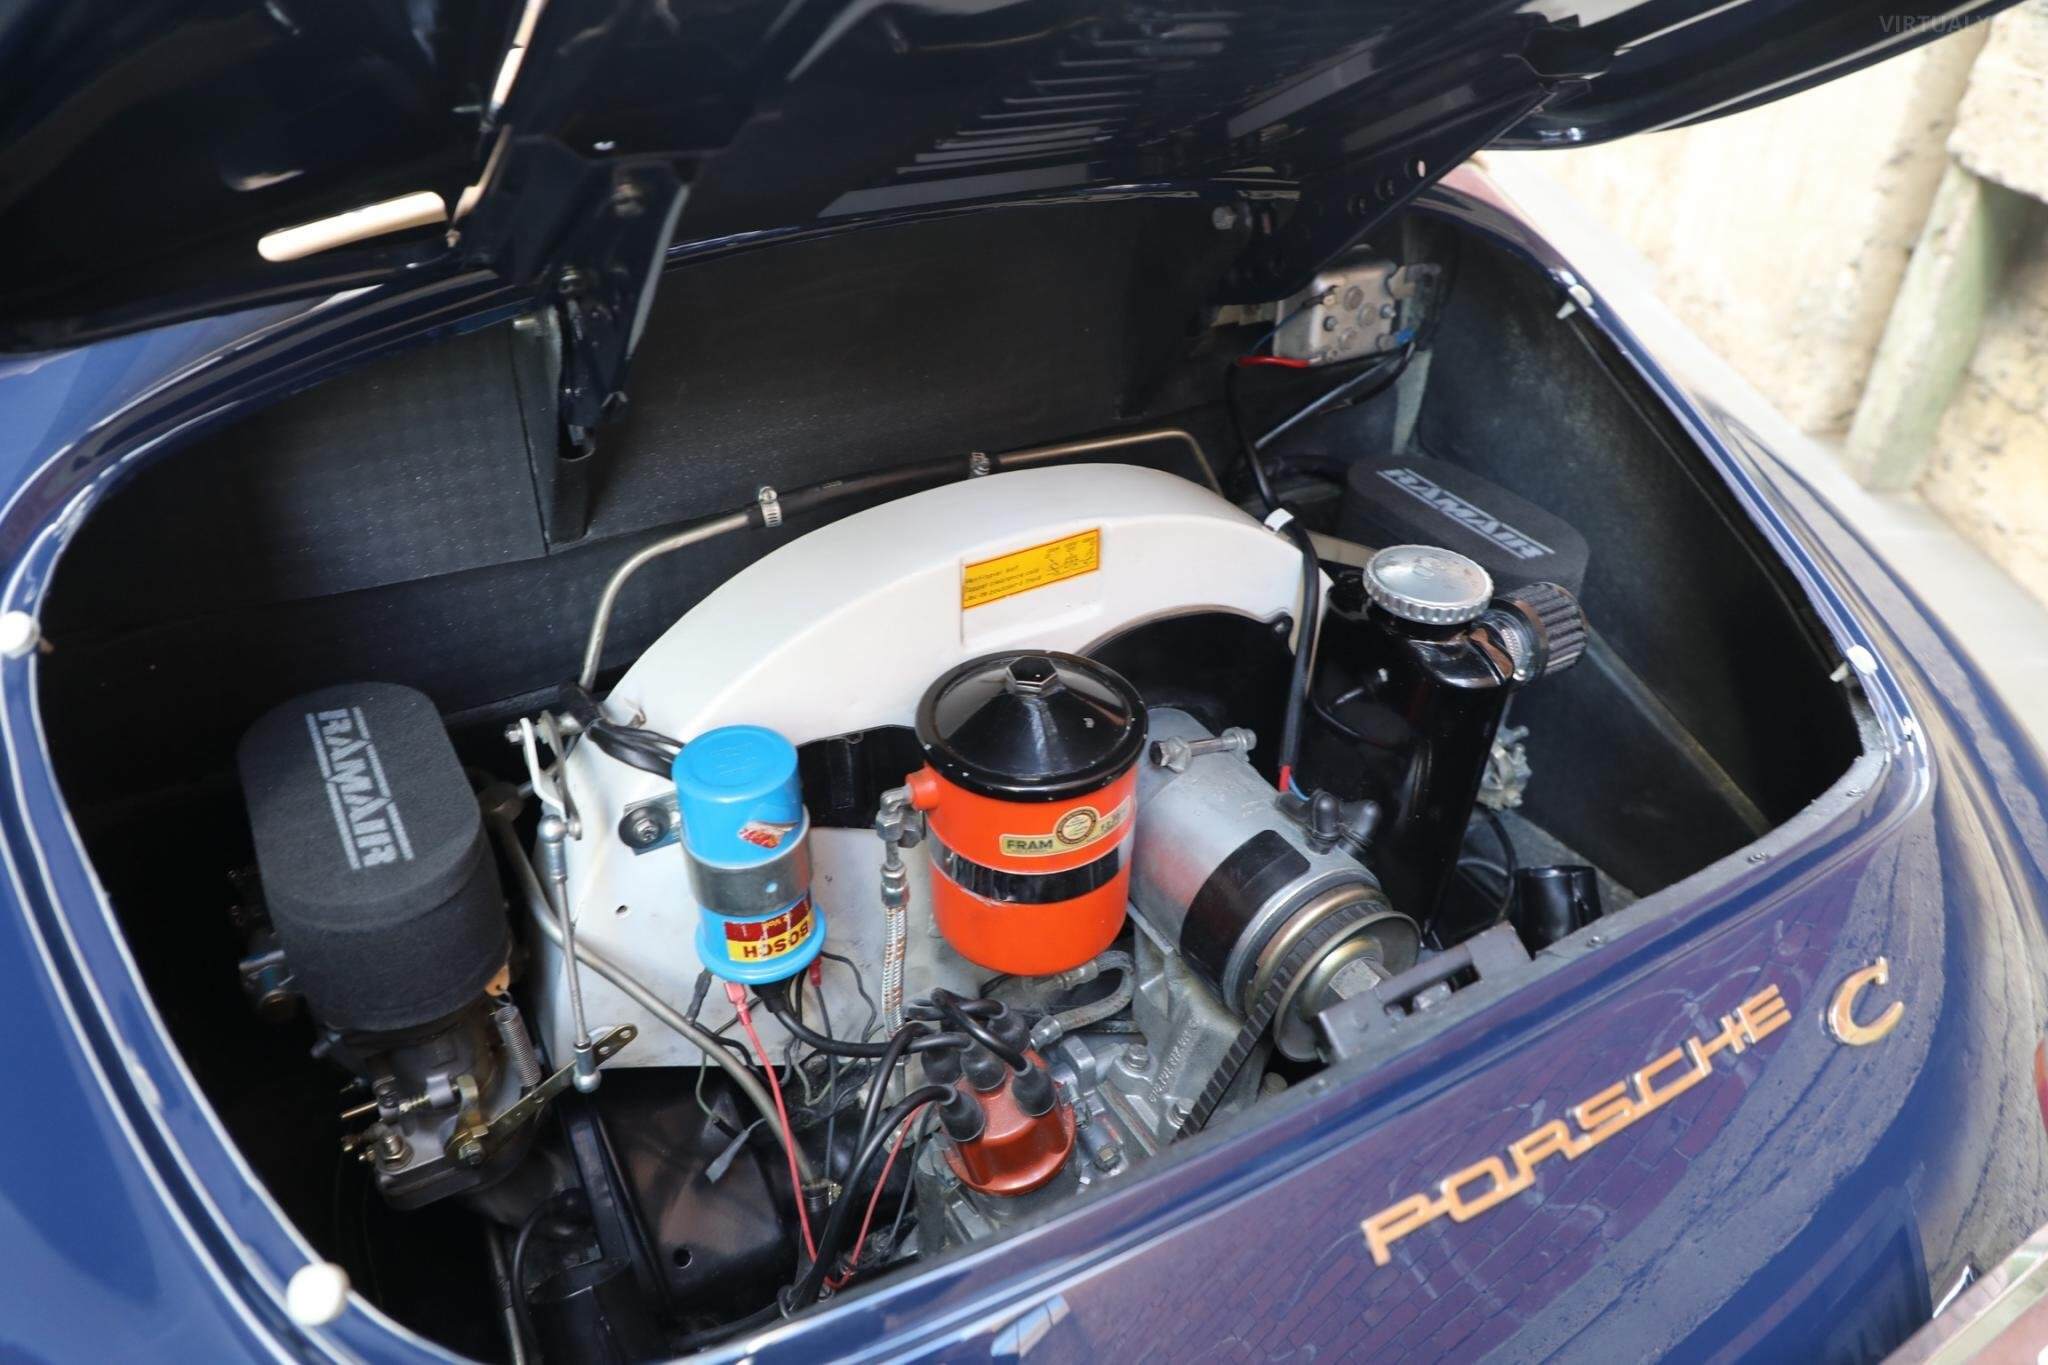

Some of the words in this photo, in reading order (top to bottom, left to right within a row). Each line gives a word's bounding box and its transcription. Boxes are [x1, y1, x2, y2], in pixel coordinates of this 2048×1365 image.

[1377, 468, 1555, 559] RAMAIR
[306, 707, 415, 869] RAMAIR
[1006, 838, 1054, 851] FRAM
[743, 920, 809, 958] BOSCH
[1360, 984, 1792, 1267] PORSCHE
[1826, 956, 1904, 1047] C
